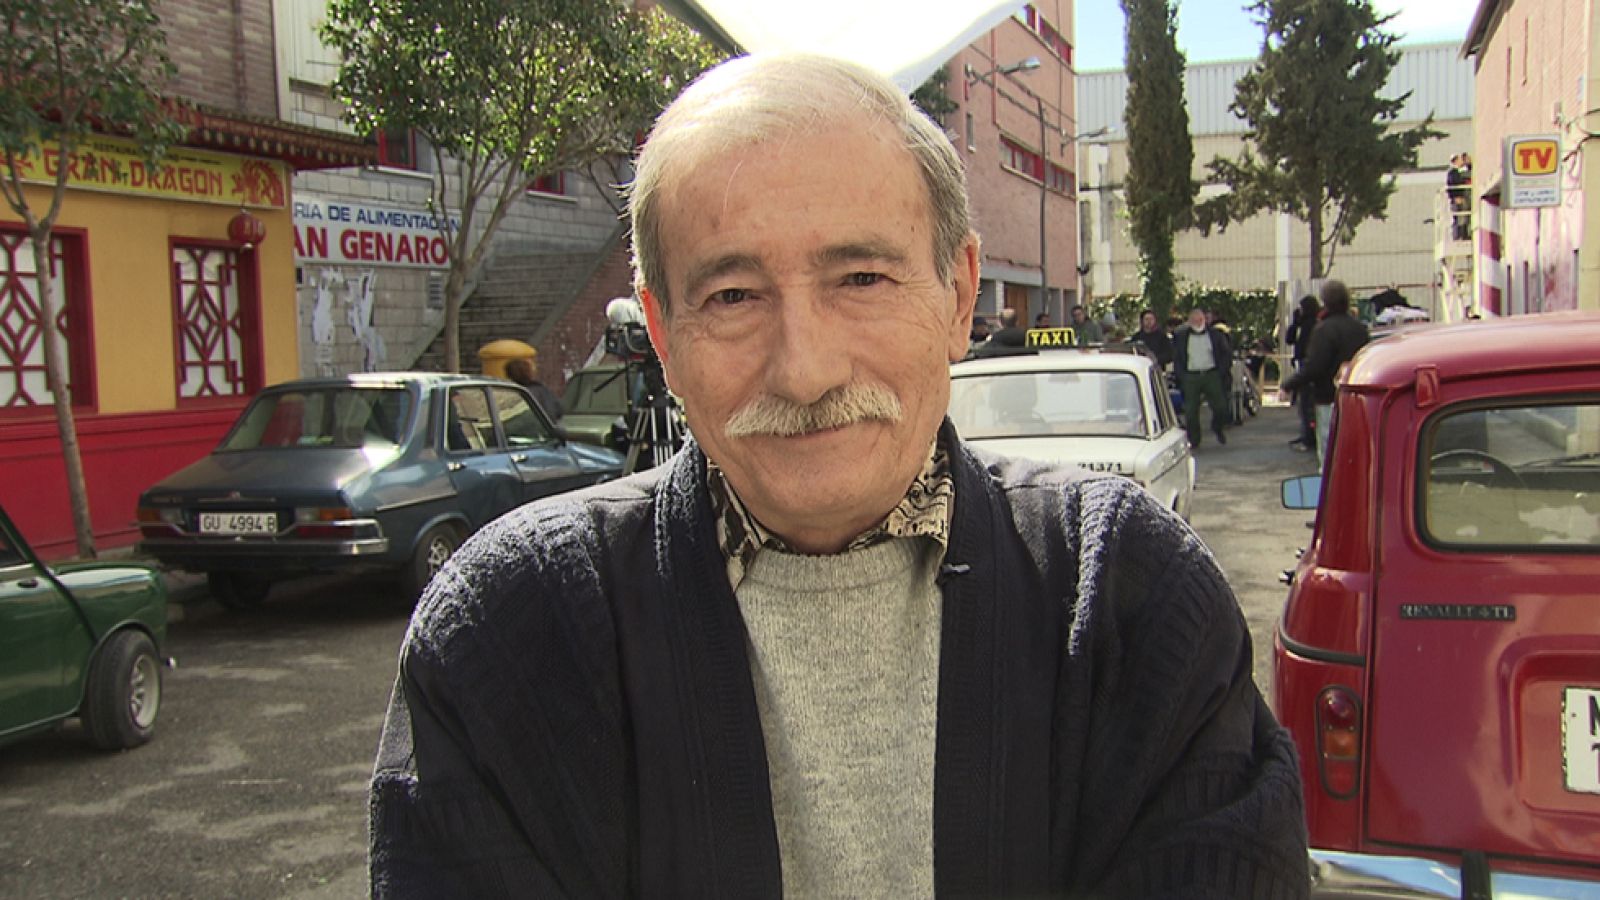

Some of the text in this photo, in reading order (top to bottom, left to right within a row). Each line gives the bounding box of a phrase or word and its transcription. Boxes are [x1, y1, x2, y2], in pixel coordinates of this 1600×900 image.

[43, 148, 117, 185] GRAN
[1519, 147, 1553, 170] TV
[328, 205, 350, 222] DE
[356, 209, 460, 232] ALIMENTACN
[340, 229, 448, 265] GENARO
[1031, 333, 1070, 346] TAXI
[203, 515, 220, 530] GU
[229, 515, 262, 532] 4994
